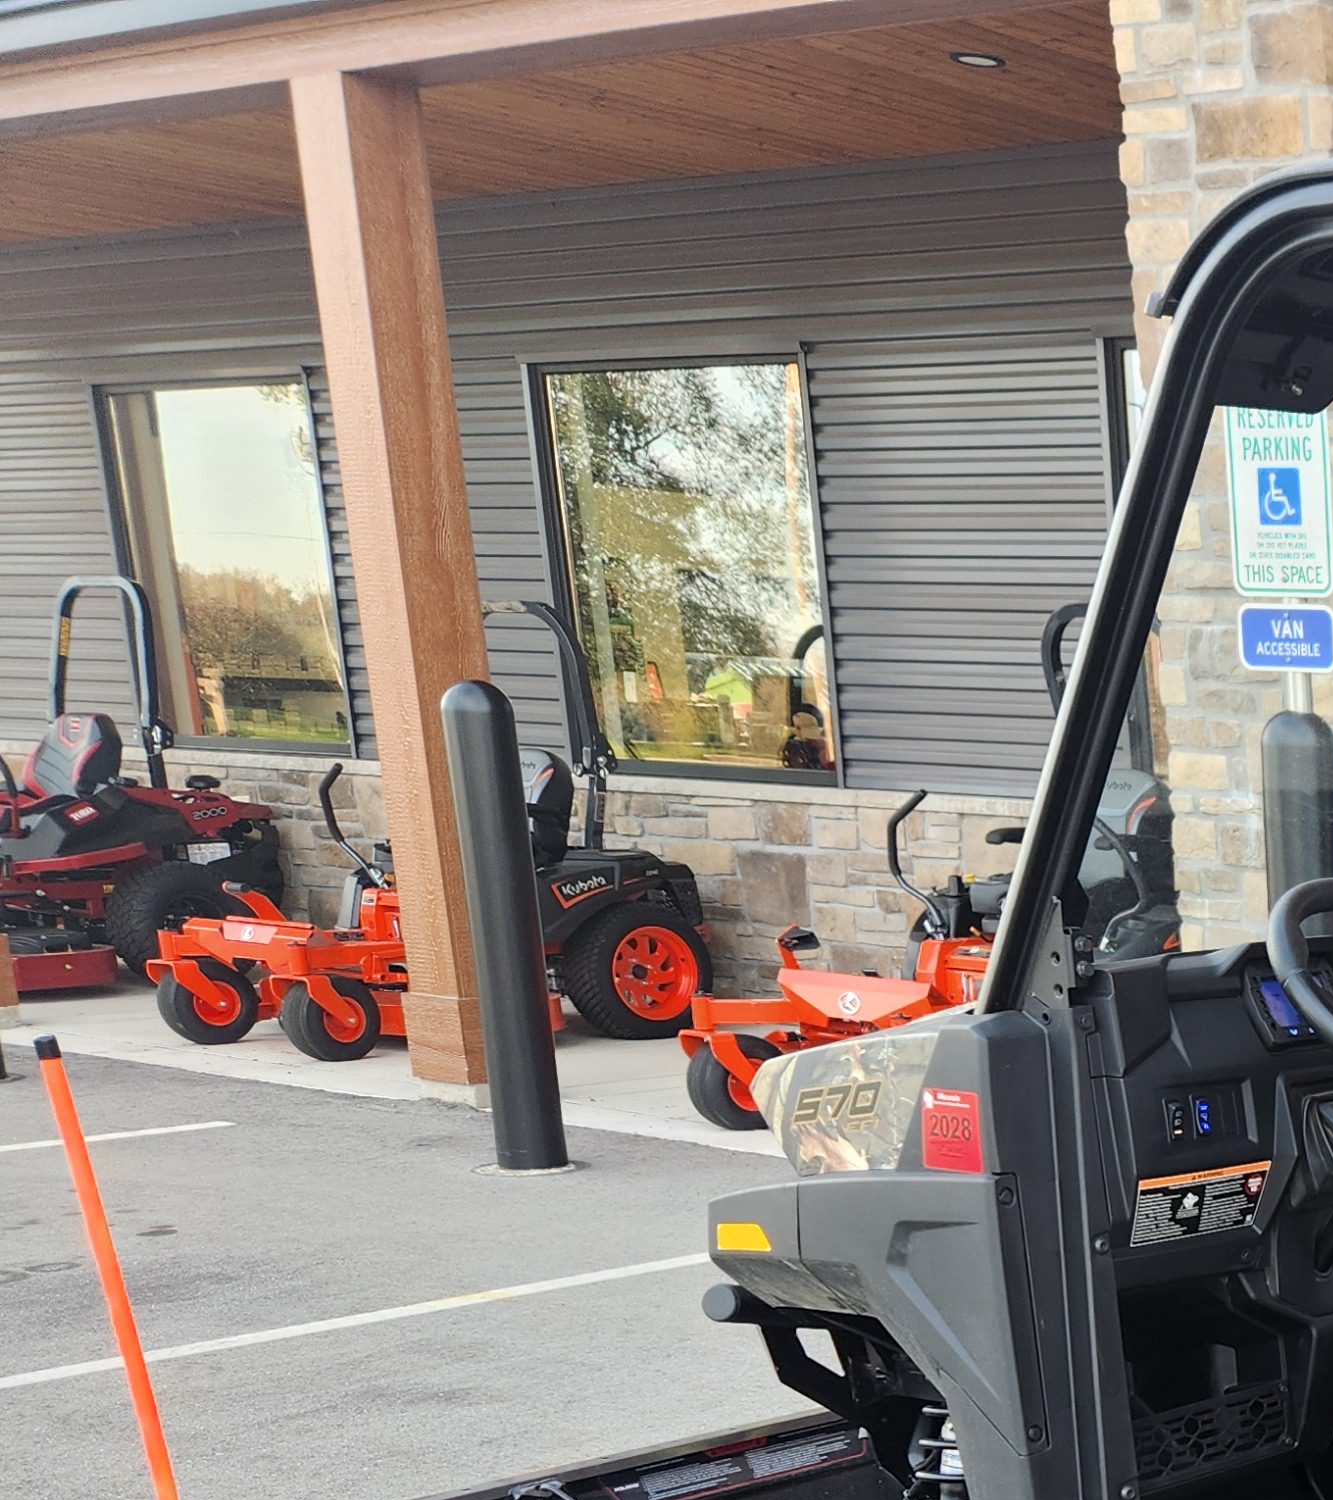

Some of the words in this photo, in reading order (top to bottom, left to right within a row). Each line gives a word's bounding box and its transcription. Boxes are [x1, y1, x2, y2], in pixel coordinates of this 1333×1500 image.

[1237, 407, 1314, 429] RESERVED
[1242, 436, 1313, 462] PARKING
[1244, 565, 1275, 582] THIS
[1280, 566, 1324, 584] SPACE
[1270, 619, 1305, 639] VAN
[1256, 642, 1322, 657] ACCESSIBLE
[191, 806, 228, 821] 2000
[560, 874, 607, 896] Kubota
[792, 1079, 883, 1125] 570
[845, 1118, 881, 1133] EFI
[929, 1113, 972, 1142] 2028
